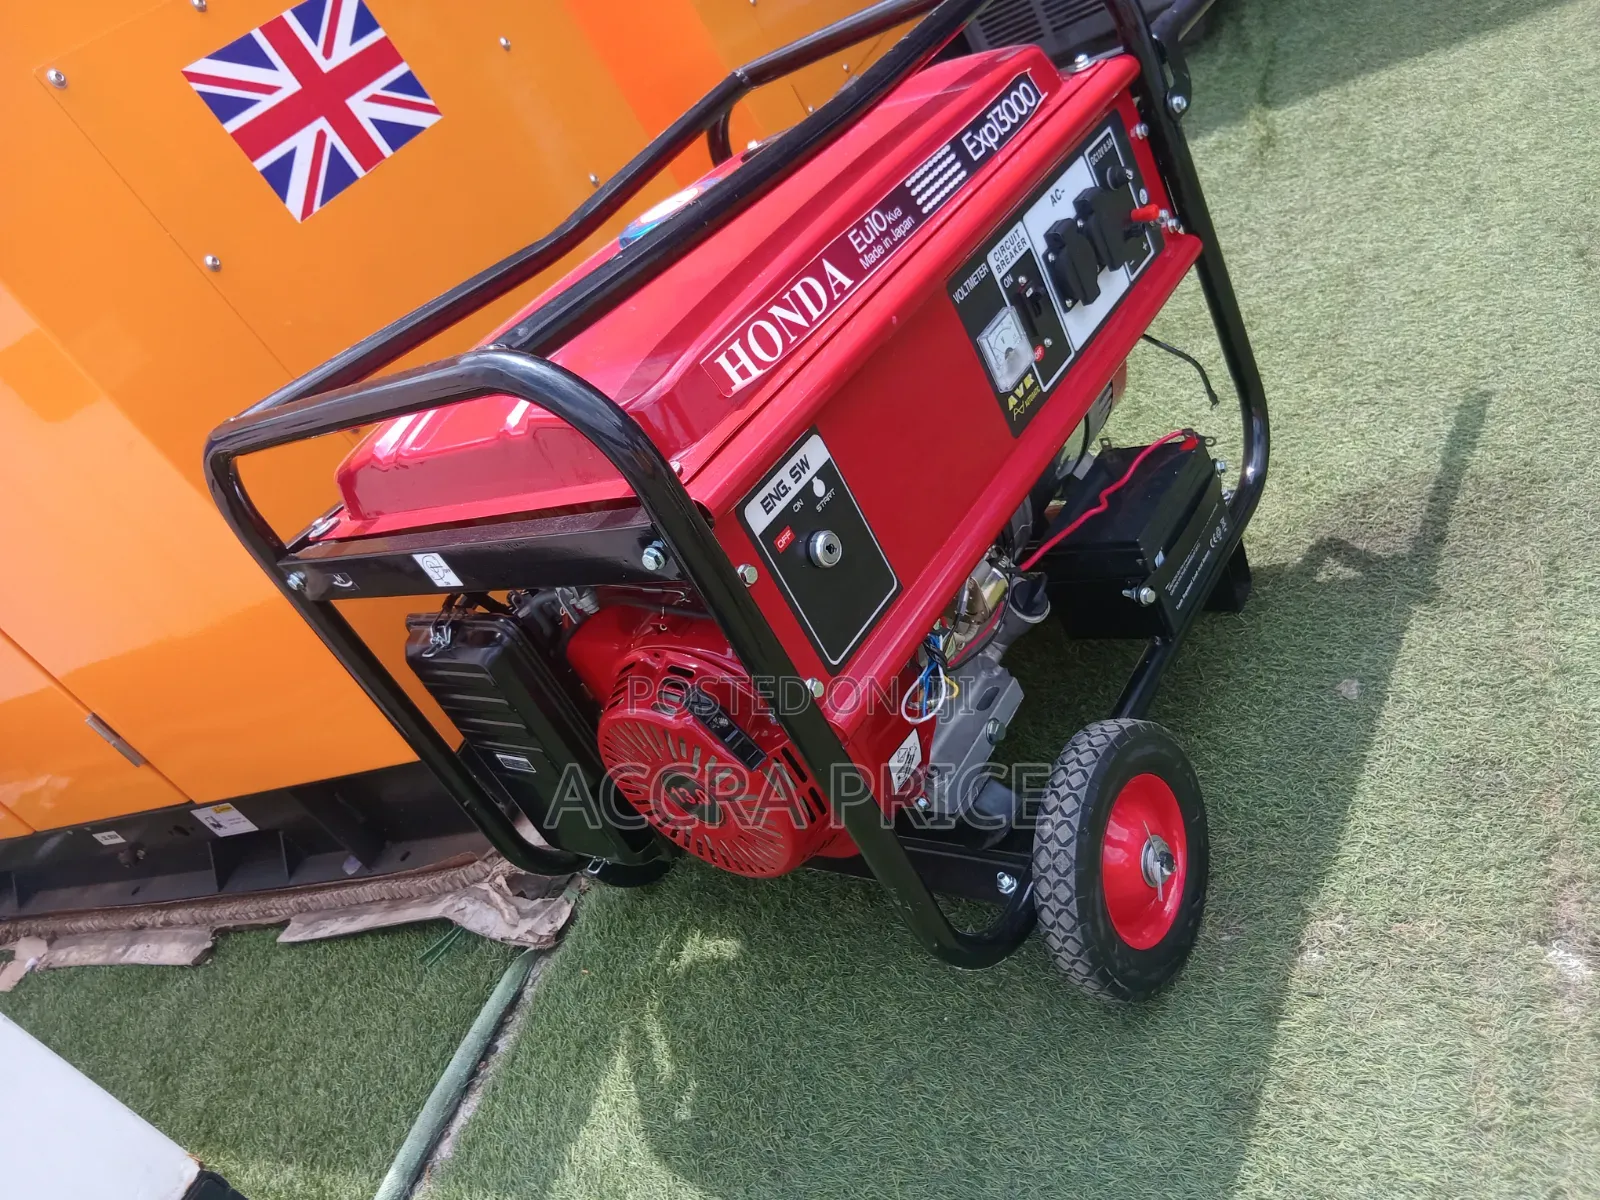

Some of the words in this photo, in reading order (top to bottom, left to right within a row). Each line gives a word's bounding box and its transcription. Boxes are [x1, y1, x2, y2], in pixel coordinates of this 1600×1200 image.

[961, 82, 1036, 161] Exp13000
[847, 210, 888, 254] Eu10
[885, 207, 903, 224] Kva
[859, 244, 885, 270] Made
[881, 236, 893, 249] in
[890, 216, 915, 242] Japan
[993, 228, 1022, 262] CIRCUIT
[995, 237, 1027, 274] BREAKER
[952, 262, 989, 304] VOLTMETER
[1003, 274, 1013, 288] ON
[714, 258, 854, 392] HONDA
[1007, 373, 1035, 411] AVR
[759, 478, 792, 515] ENG.
[789, 454, 811, 484] SW
[815, 488, 836, 513] START
[792, 498, 804, 513] ON
[777, 529, 793, 549] OFF
